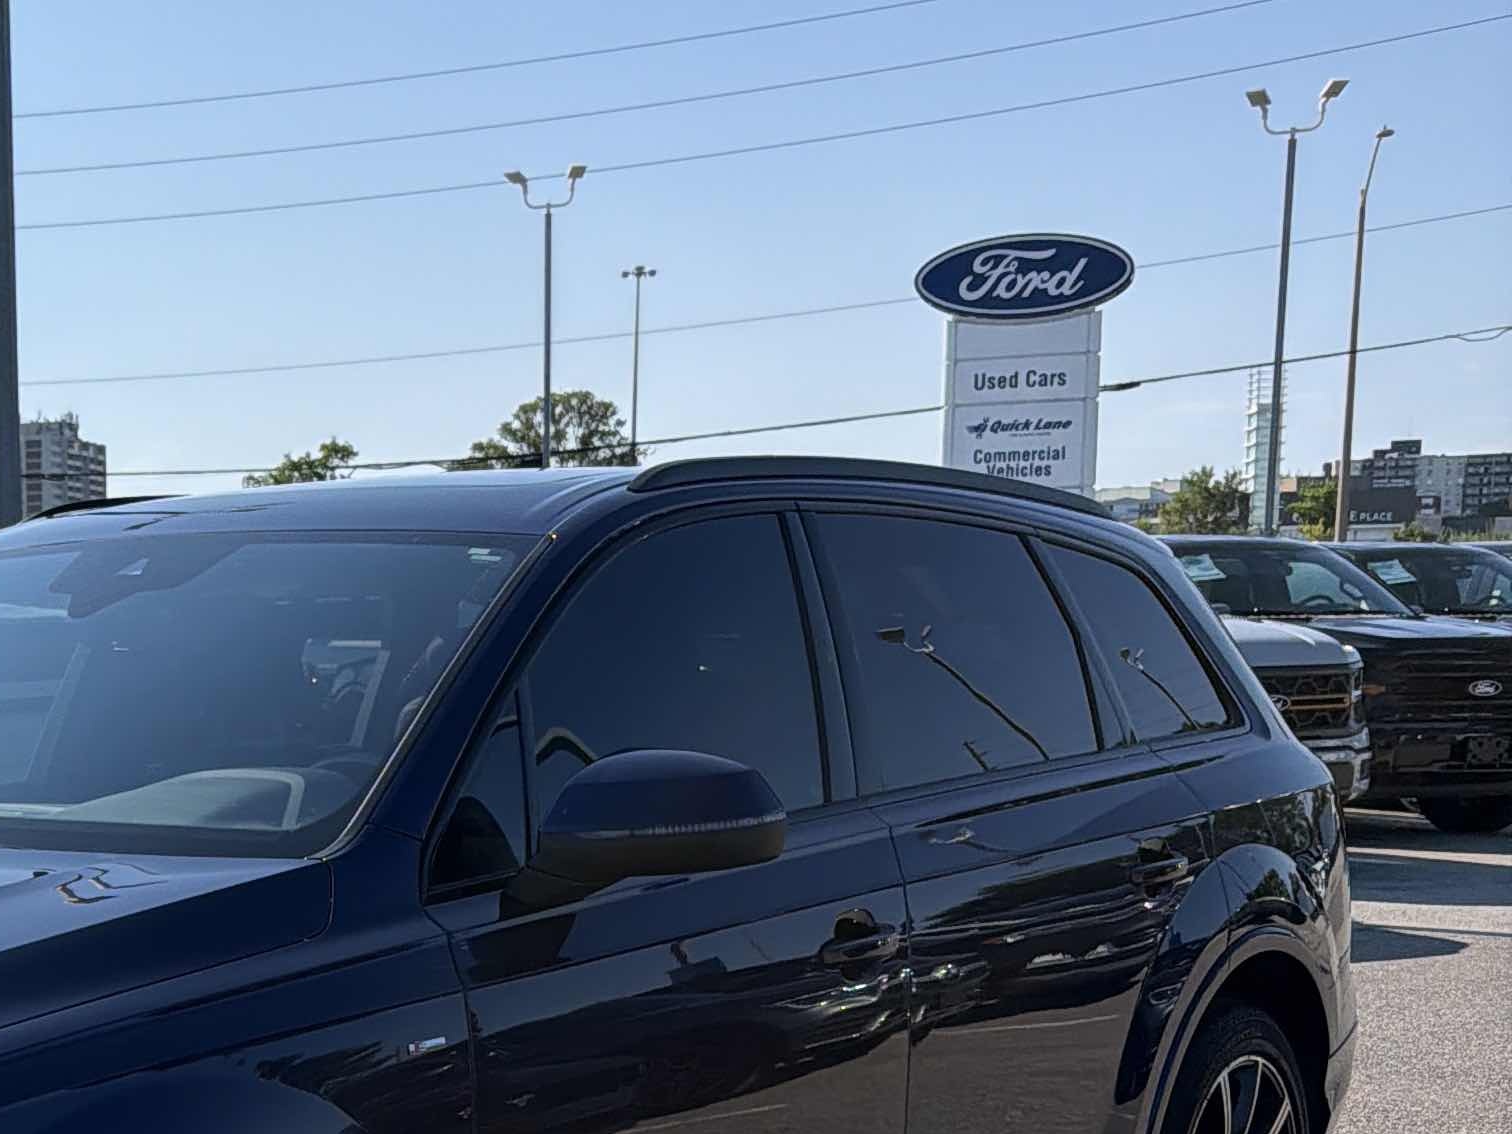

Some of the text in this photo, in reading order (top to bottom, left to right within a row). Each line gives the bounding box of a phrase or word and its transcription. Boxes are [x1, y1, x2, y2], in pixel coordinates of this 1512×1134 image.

[958, 247, 1088, 301] Ford
[973, 369, 1067, 391] Used Cars
[989, 418, 1032, 434] Quick
[1033, 418, 1073, 430] Lane
[973, 445, 1066, 464] Commercial
[986, 463, 1052, 477] Vehicles
[1359, 511, 1393, 521] PLACE
